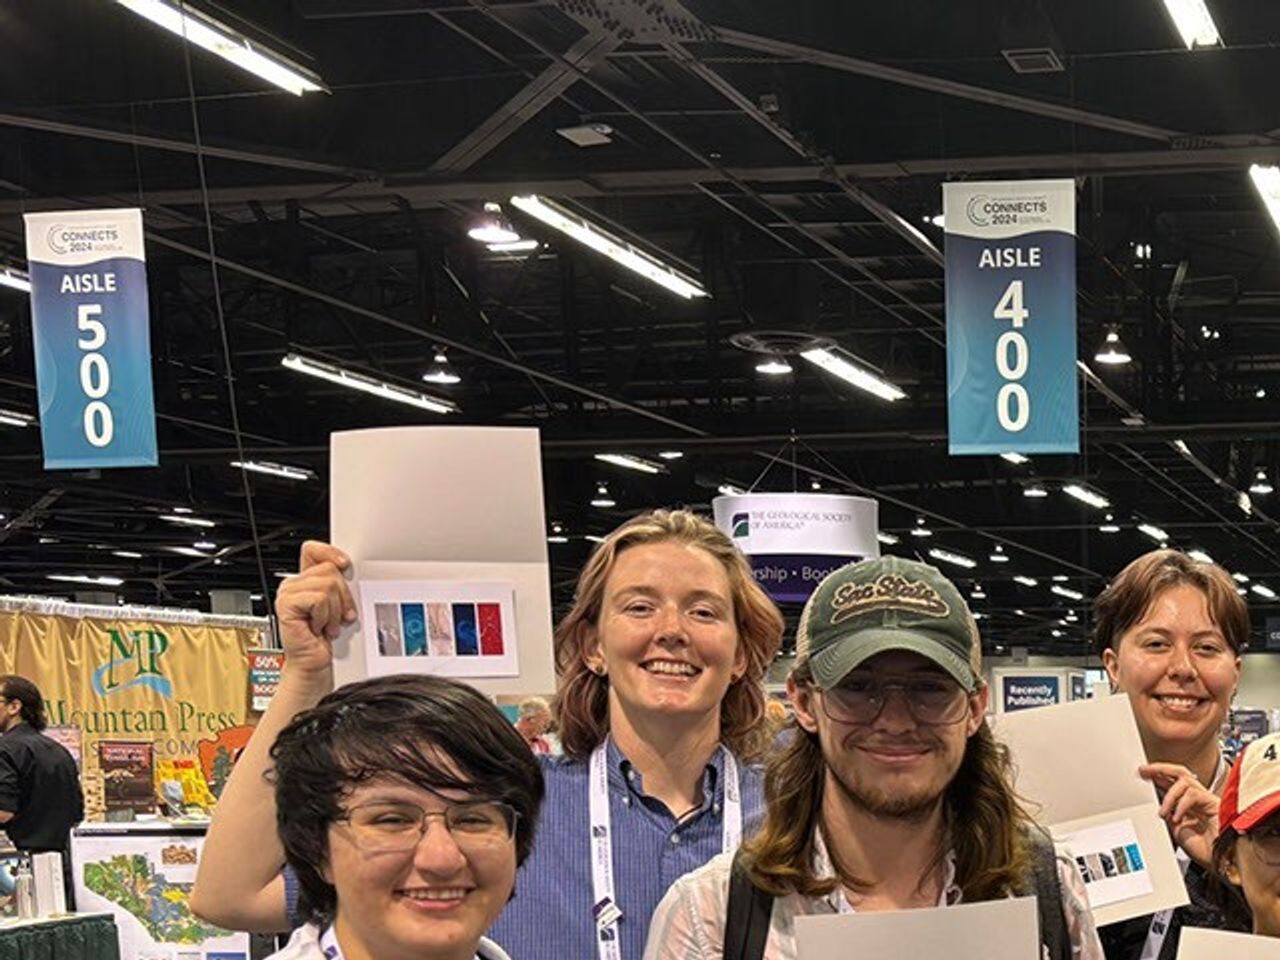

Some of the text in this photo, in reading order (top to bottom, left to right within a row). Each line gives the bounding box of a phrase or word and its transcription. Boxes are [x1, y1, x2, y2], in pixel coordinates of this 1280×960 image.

[983, 201, 1047, 214] CONNECTS
[992, 214, 1017, 225] 2024
[61, 230, 118, 242] CONNECTS
[70, 242, 92, 252] 2024
[979, 248, 1041, 268] AISLE
[60, 273, 116, 293] AISLE
[993, 280, 1030, 432] 400
[77, 303, 113, 447] 500
[802, 566, 834, 580] Boo
[834, 575, 936, 606] Sac State
[1010, 685, 1053, 696] Recently
[1008, 696, 1055, 705] Published
[178, 702, 237, 732] Press
